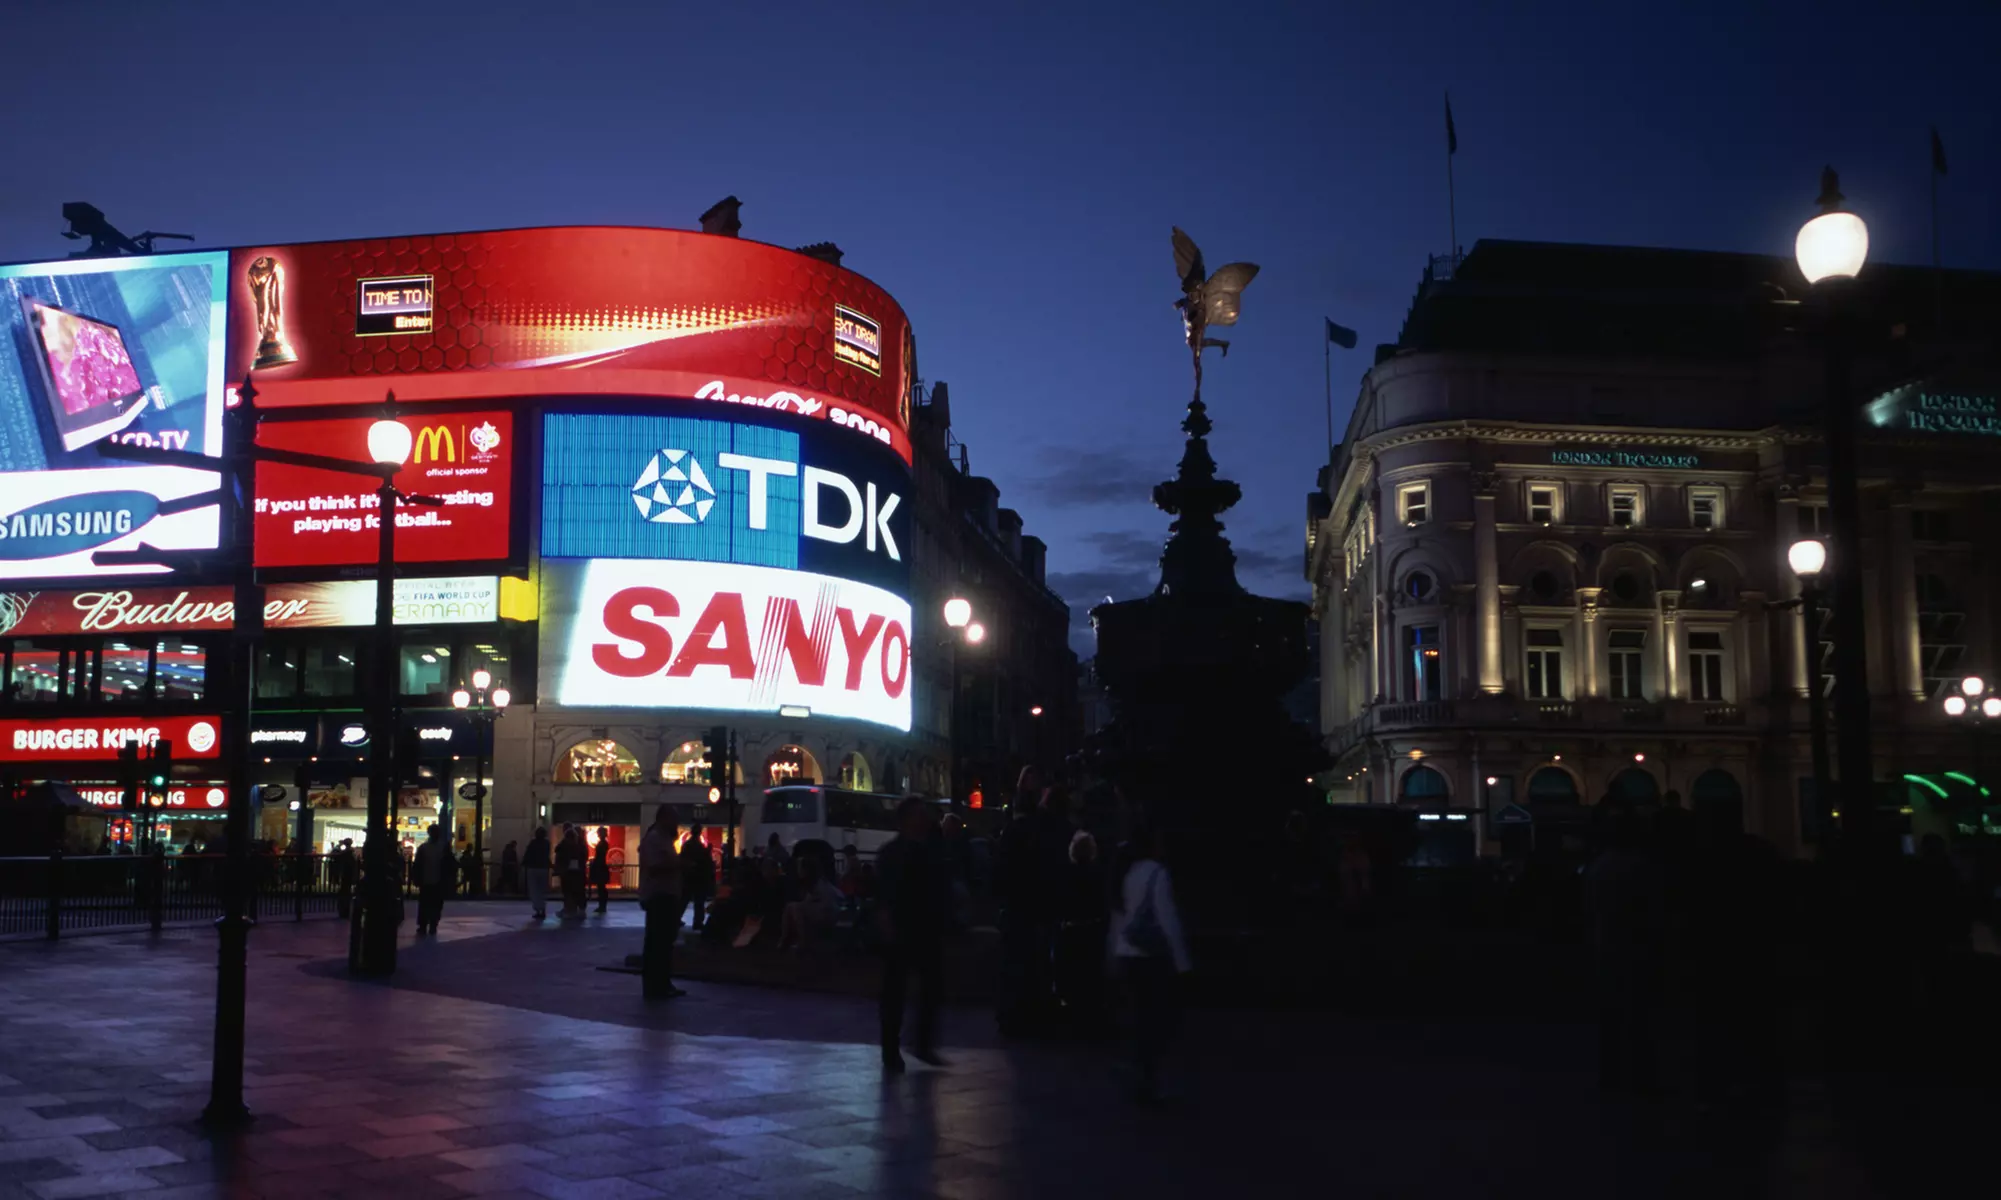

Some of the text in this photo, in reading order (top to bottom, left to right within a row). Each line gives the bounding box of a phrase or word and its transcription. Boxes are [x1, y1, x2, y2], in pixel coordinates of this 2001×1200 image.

[365, 290, 400, 306] TIME
[403, 289, 423, 304] TO
[254, 498, 269, 513] If
[270, 499, 307, 515] you
[308, 495, 357, 511] think
[718, 451, 902, 561] TDK
[293, 515, 363, 534] playing
[413, 592, 435, 600] FIFA
[437, 592, 470, 600] WORLD
[472, 591, 491, 599] CUP
[72, 590, 309, 630] Budweer
[392, 602, 490, 618] ERMANY
[592, 584, 910, 701] SANYO
[13, 727, 161, 749] BURGER KING
